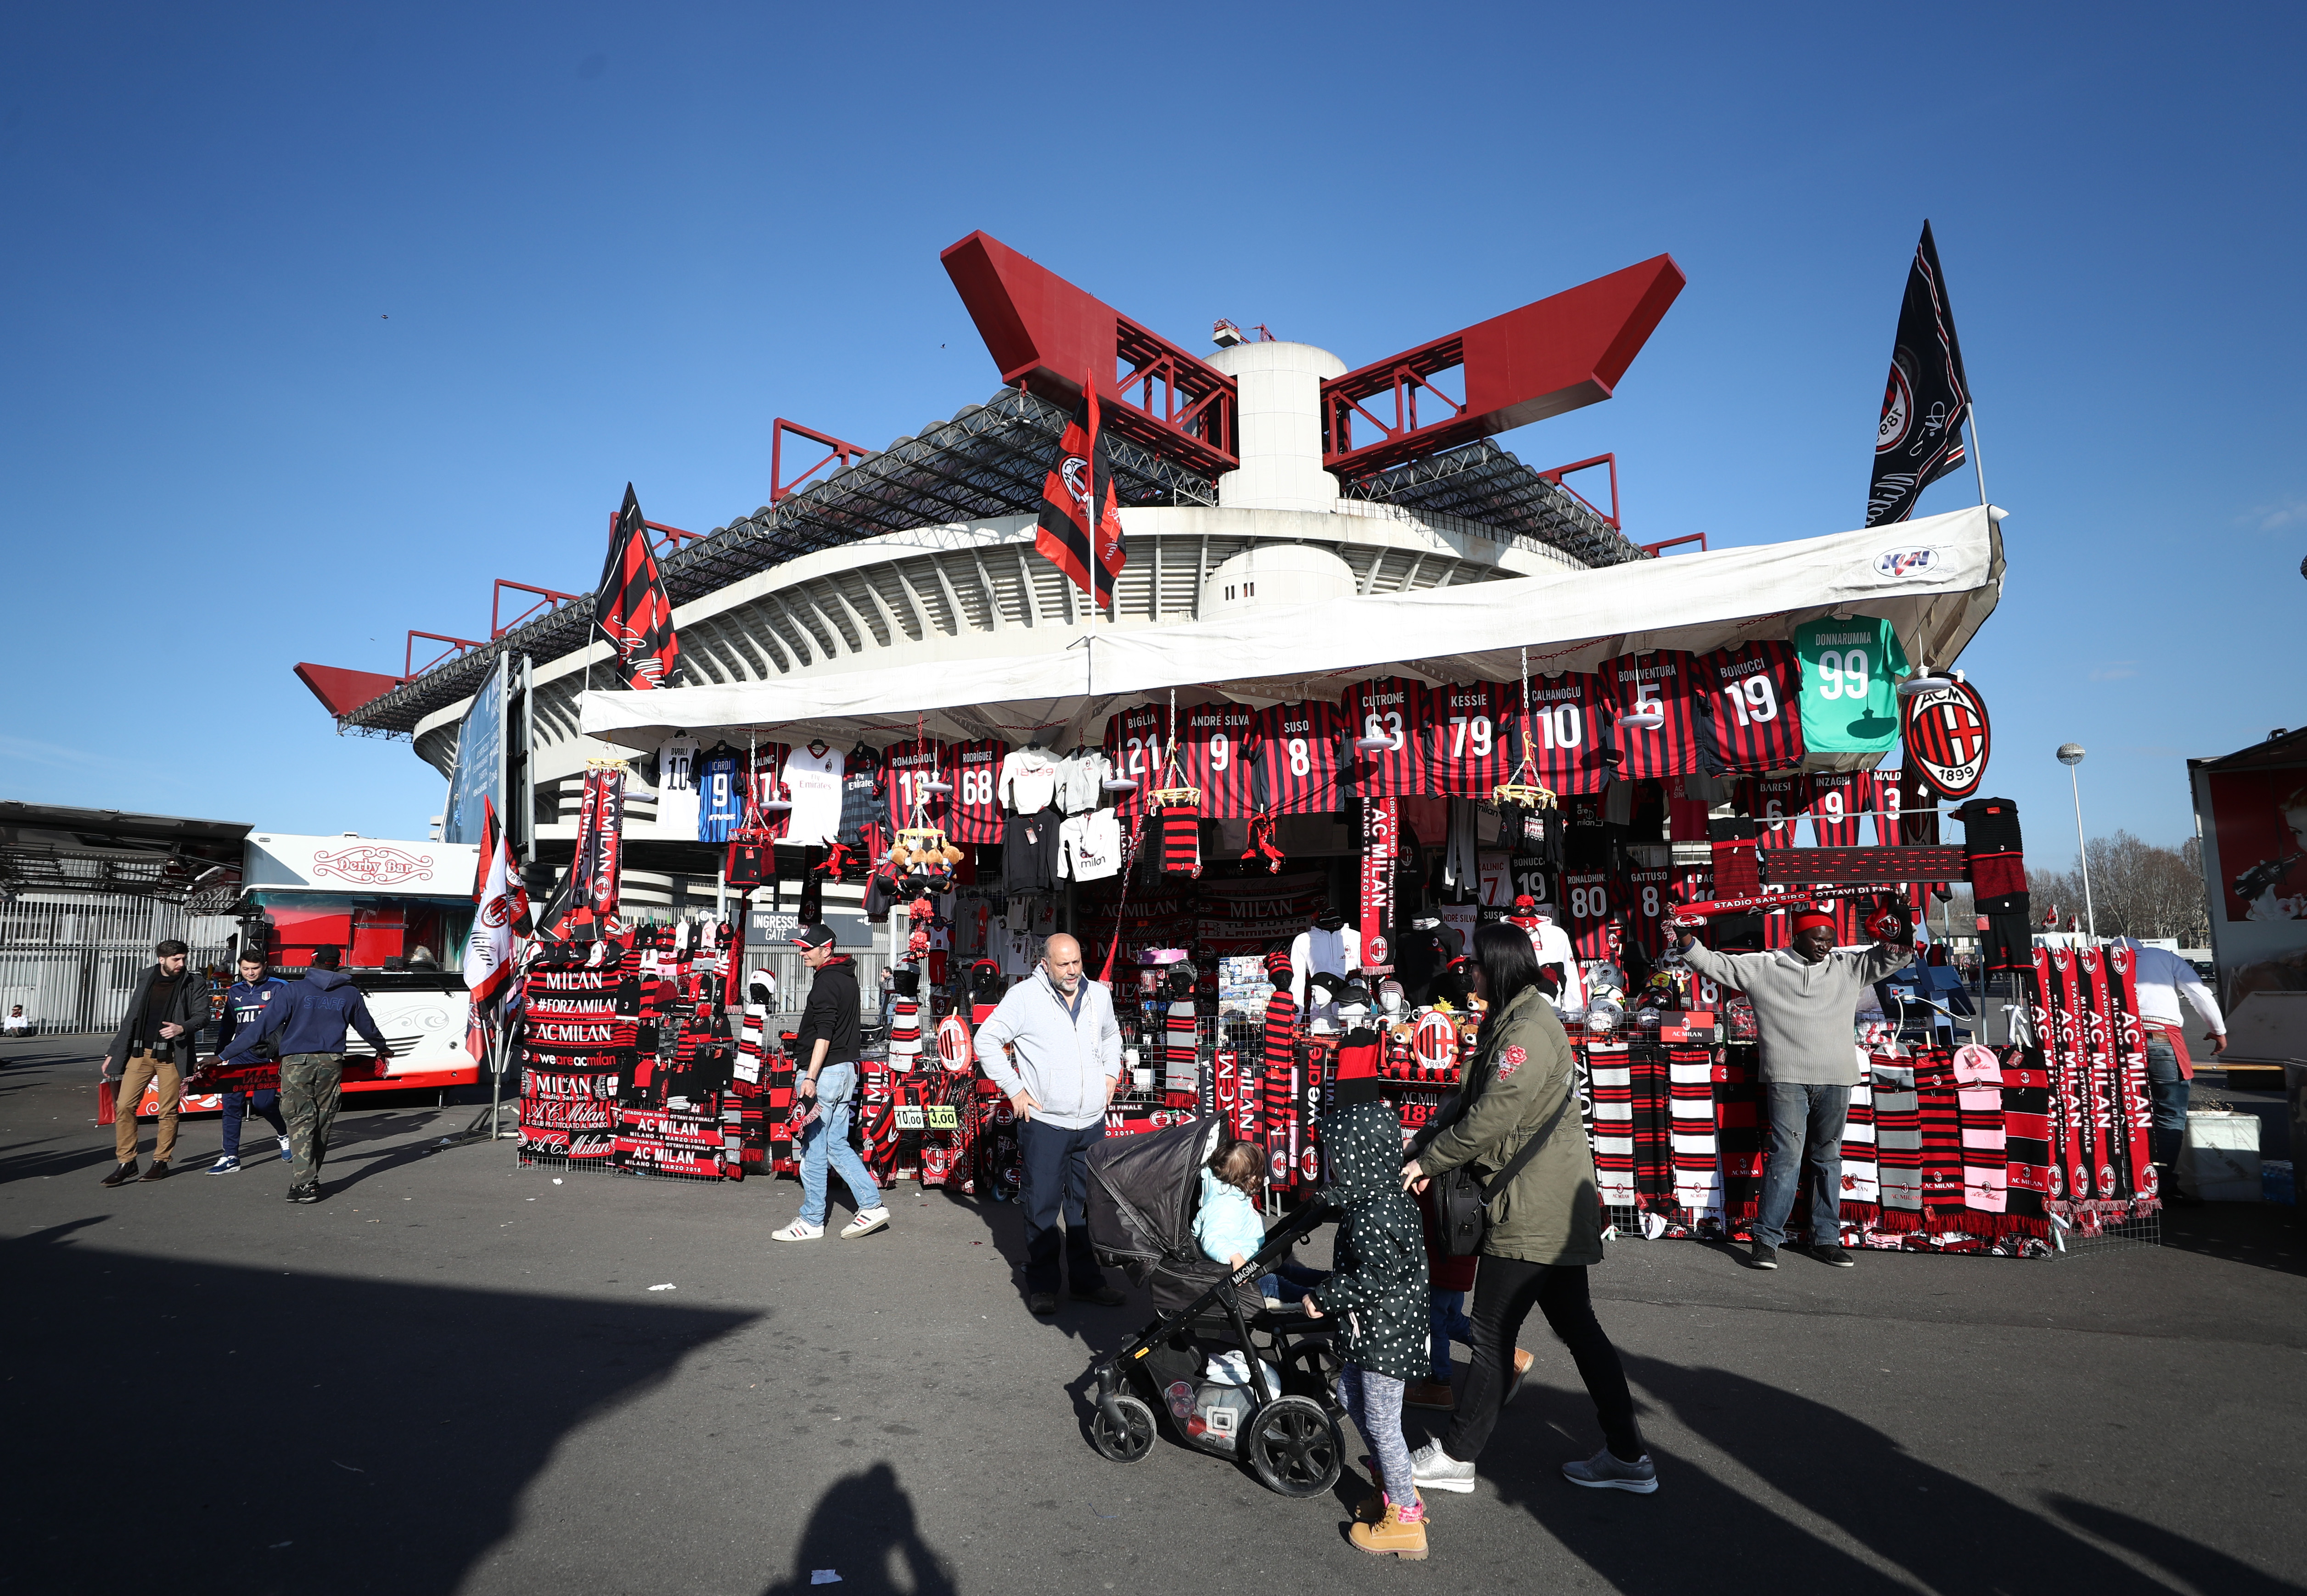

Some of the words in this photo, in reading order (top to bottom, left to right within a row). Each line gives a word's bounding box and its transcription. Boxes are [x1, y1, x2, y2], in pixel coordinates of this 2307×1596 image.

[1816, 631, 1872, 646] DONNARUMMA
[1618, 664, 1677, 682] BONAVENTURA
[1720, 657, 1766, 679] BONUCCI
[1819, 649, 1869, 700] 99
[1362, 692, 1405, 708] CUTRONE
[1451, 694, 1487, 707] KESSIE
[1724, 674, 1778, 727] 19
[1919, 685, 1965, 709] ACM
[1128, 713, 1156, 729] BIGLIA
[1224, 715, 1250, 726] SILVA
[1284, 720, 1309, 734] SUSO
[1536, 703, 1582, 750] 10
[1449, 715, 1492, 758] 79
[963, 750, 993, 763] RODRÍGUEZ
[1127, 733, 1160, 775] 21
[1210, 733, 1229, 771] 9
[1288, 738, 1310, 777] 8
[668, 756, 690, 790] 10
[712, 760, 731, 772] ICARDI
[1938, 766, 1975, 782] 1899
[712, 773, 728, 807] 9
[799, 780, 832, 790] Emirates
[848, 779, 874, 790] Emirates
[963, 769, 993, 806] 68
[1760, 782, 1791, 792] BARESI
[1816, 776, 1851, 786] INZAGHI
[1824, 791, 1844, 824] 9
[1884, 788, 1901, 820] 3
[1371, 808, 1388, 837] AC
[1766, 799, 1784, 831] 6
[338, 857, 381, 874] Derby
[386, 860, 413, 874] Bar
[1080, 856, 1106, 868] milan
[1371, 843, 1388, 907] MILAN
[1631, 872, 1667, 882] GATTUSO
[1483, 877, 1499, 905] 7
[1517, 872, 1546, 902] 19
[1230, 898, 1293, 918] MILAN
[1571, 886, 1607, 918] 80
[1642, 886, 1660, 917] 8
[1714, 899, 1752, 909] STADIO
[1755, 896, 1777, 904] SAN
[1816, 888, 1855, 897] OTTAVI
[485, 912, 496, 925] 1899
[753, 914, 798, 930] INGRESSO
[1443, 913, 1458, 923] NDRÉ
[1460, 914, 1476, 923] SILVA
[1484, 911, 1504, 919] SUSO
[765, 928, 786, 941] GATE
[546, 971, 602, 990] MILAN
[303, 995, 346, 1011] STAFF
[236, 1010, 262, 1024] ITAL
[1424, 1014, 1447, 1027] ACM
[2035, 1005, 2050, 1041] AC
[2060, 1008, 2075, 1042] AC
[2089, 1010, 2105, 1044] AC
[2121, 1011, 2140, 1044] AC
[1425, 1060, 1446, 1068] 1899
[2111, 997, 2123, 1046] MILANO
[2121, 1067, 2133, 1111] MARZO
[2127, 1115, 2136, 1142] 2018
[536, 1075, 590, 1094] MILAN
[2064, 1051, 2082, 1128] MILAN
[2092, 1053, 2112, 1128] MILAN
[2127, 1053, 2153, 1128] MILAN
[539, 1092, 560, 1101] Stadio
[897, 1108, 921, 1126] 10,00
[929, 1108, 954, 1126] 3,00
[637, 1118, 655, 1132] AC
[658, 1120, 699, 1137] MILAN
[624, 1159, 650, 1167] MILANO
[632, 1146, 651, 1160] AC
[654, 1148, 695, 1165] MILAN
[2021, 1178, 2043, 1187] MILAN
[1232, 1260, 1260, 1285] MAGMA
